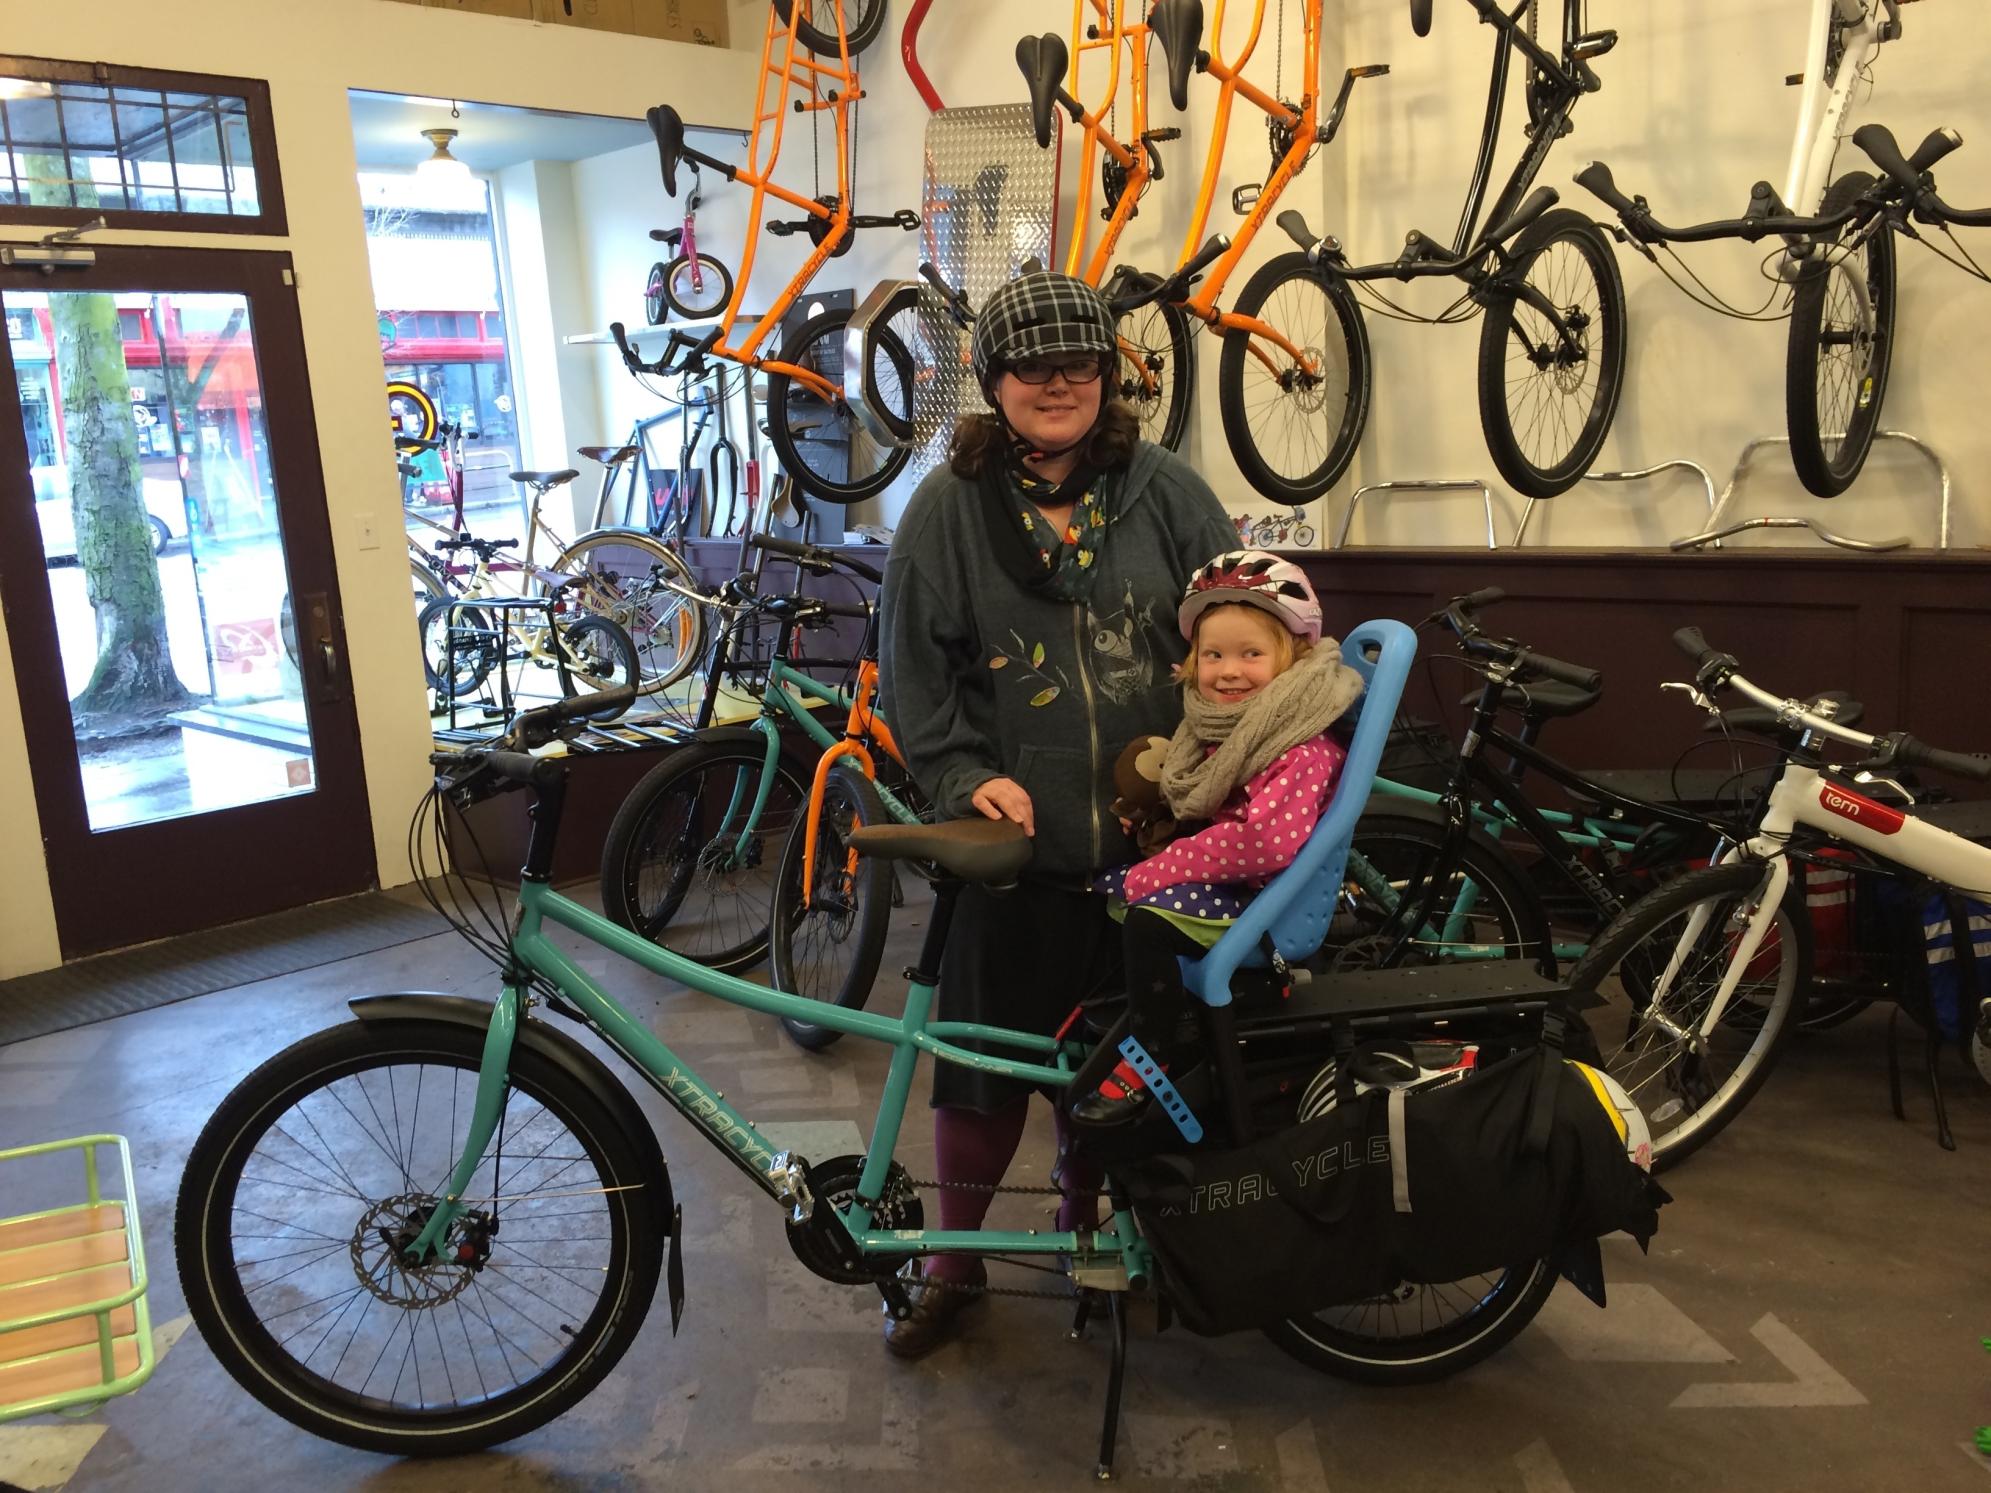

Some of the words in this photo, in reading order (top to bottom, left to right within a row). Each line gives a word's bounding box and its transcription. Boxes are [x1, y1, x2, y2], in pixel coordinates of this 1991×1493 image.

[1251, 160, 1299, 229] XTRACYCLE
[788, 242, 831, 298] XTRACYCLE
[1825, 791, 1861, 816] tern
[660, 1066, 774, 1178] XTRACYC
